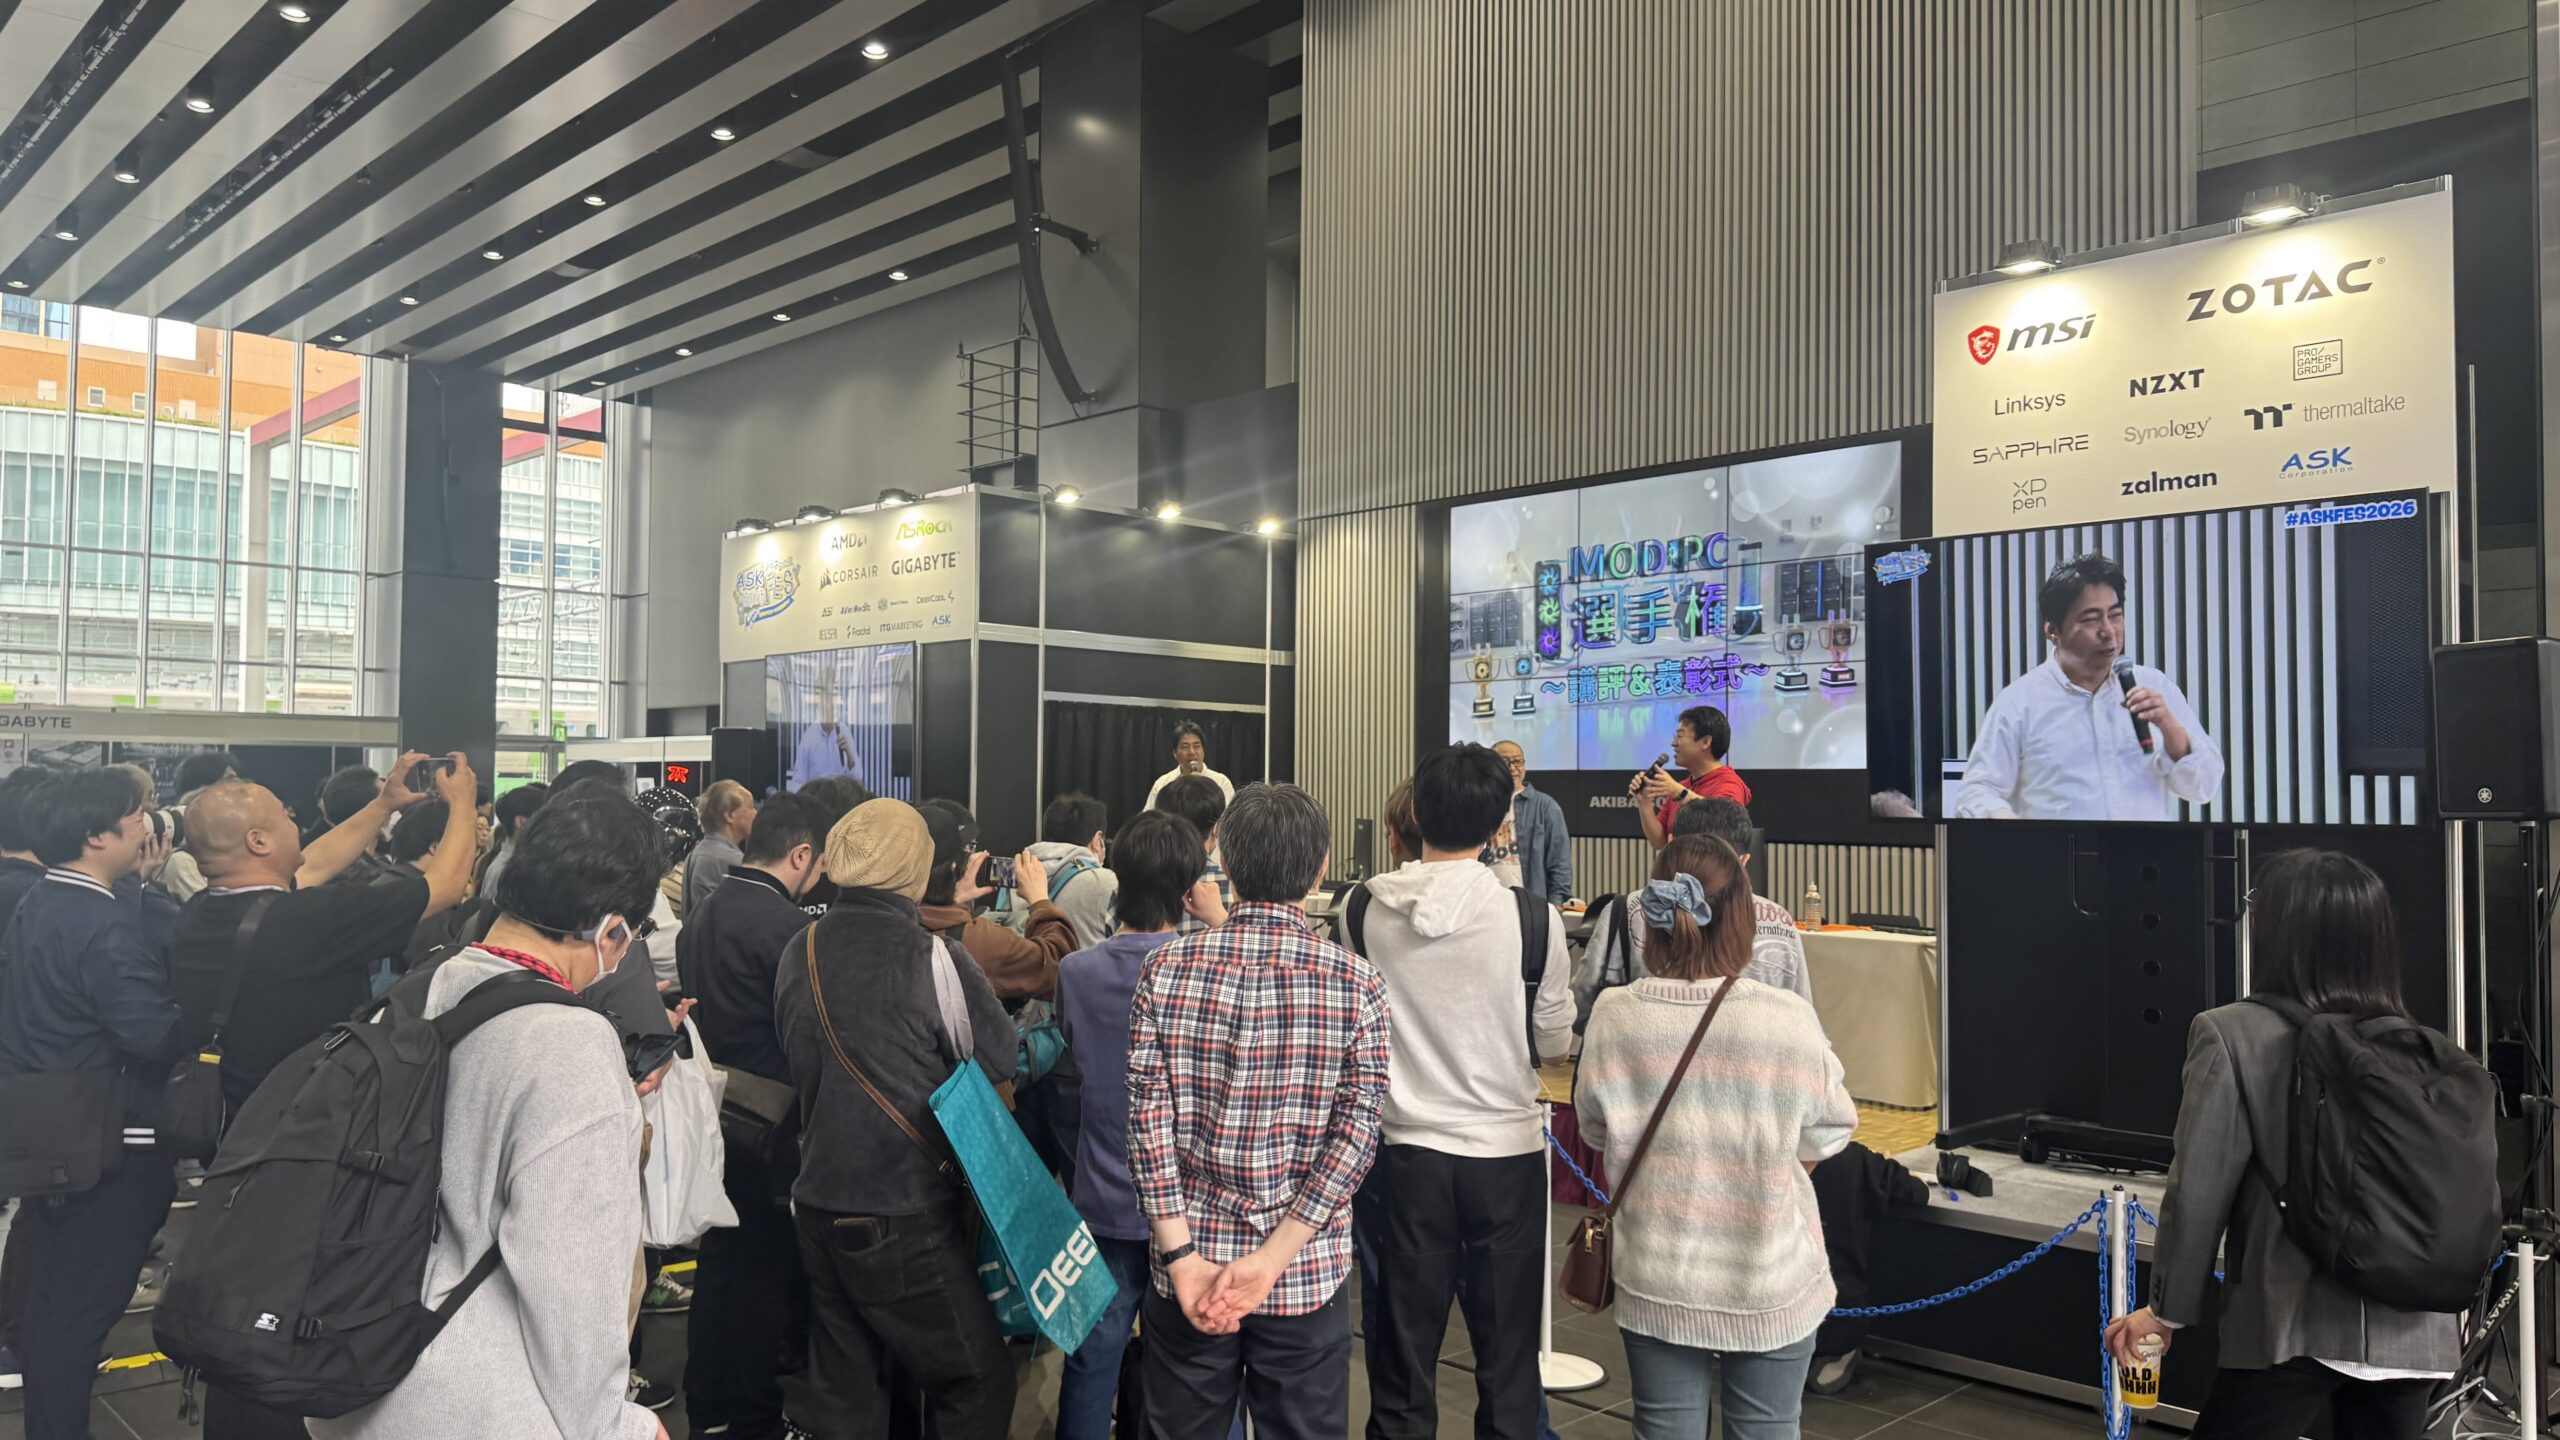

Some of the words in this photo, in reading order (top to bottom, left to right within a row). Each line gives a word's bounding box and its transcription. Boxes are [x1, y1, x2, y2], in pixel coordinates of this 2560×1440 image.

[2187, 258, 2373, 322] ZOTAC
[2006, 313, 2098, 353] msi
[2297, 353, 2339, 367] GAMERS
[2297, 363, 2331, 376] GROUP
[2129, 368, 2205, 398] NZXT
[1994, 392, 2066, 416] Linksys
[2303, 393, 2406, 423] thermaltake
[2123, 418, 2209, 446] Synology
[1972, 434, 2089, 465] SAPPHIRE
[2281, 446, 2352, 472] ASK
[2121, 471, 2218, 496] zalman
[2279, 466, 2354, 480] Corporation
[2013, 478, 2047, 496] XP
[2012, 495, 2047, 514] pen
[2285, 499, 2417, 528] #ASKFES2026
[831, 533, 858, 550] AMD
[833, 564, 879, 584] CORSAIR
[891, 551, 957, 576] GIGABYTE
[931, 614, 951, 627] ASK
[1573, 582, 1728, 650] 選手権
[2476, 1275, 2520, 1340] TIMATE
